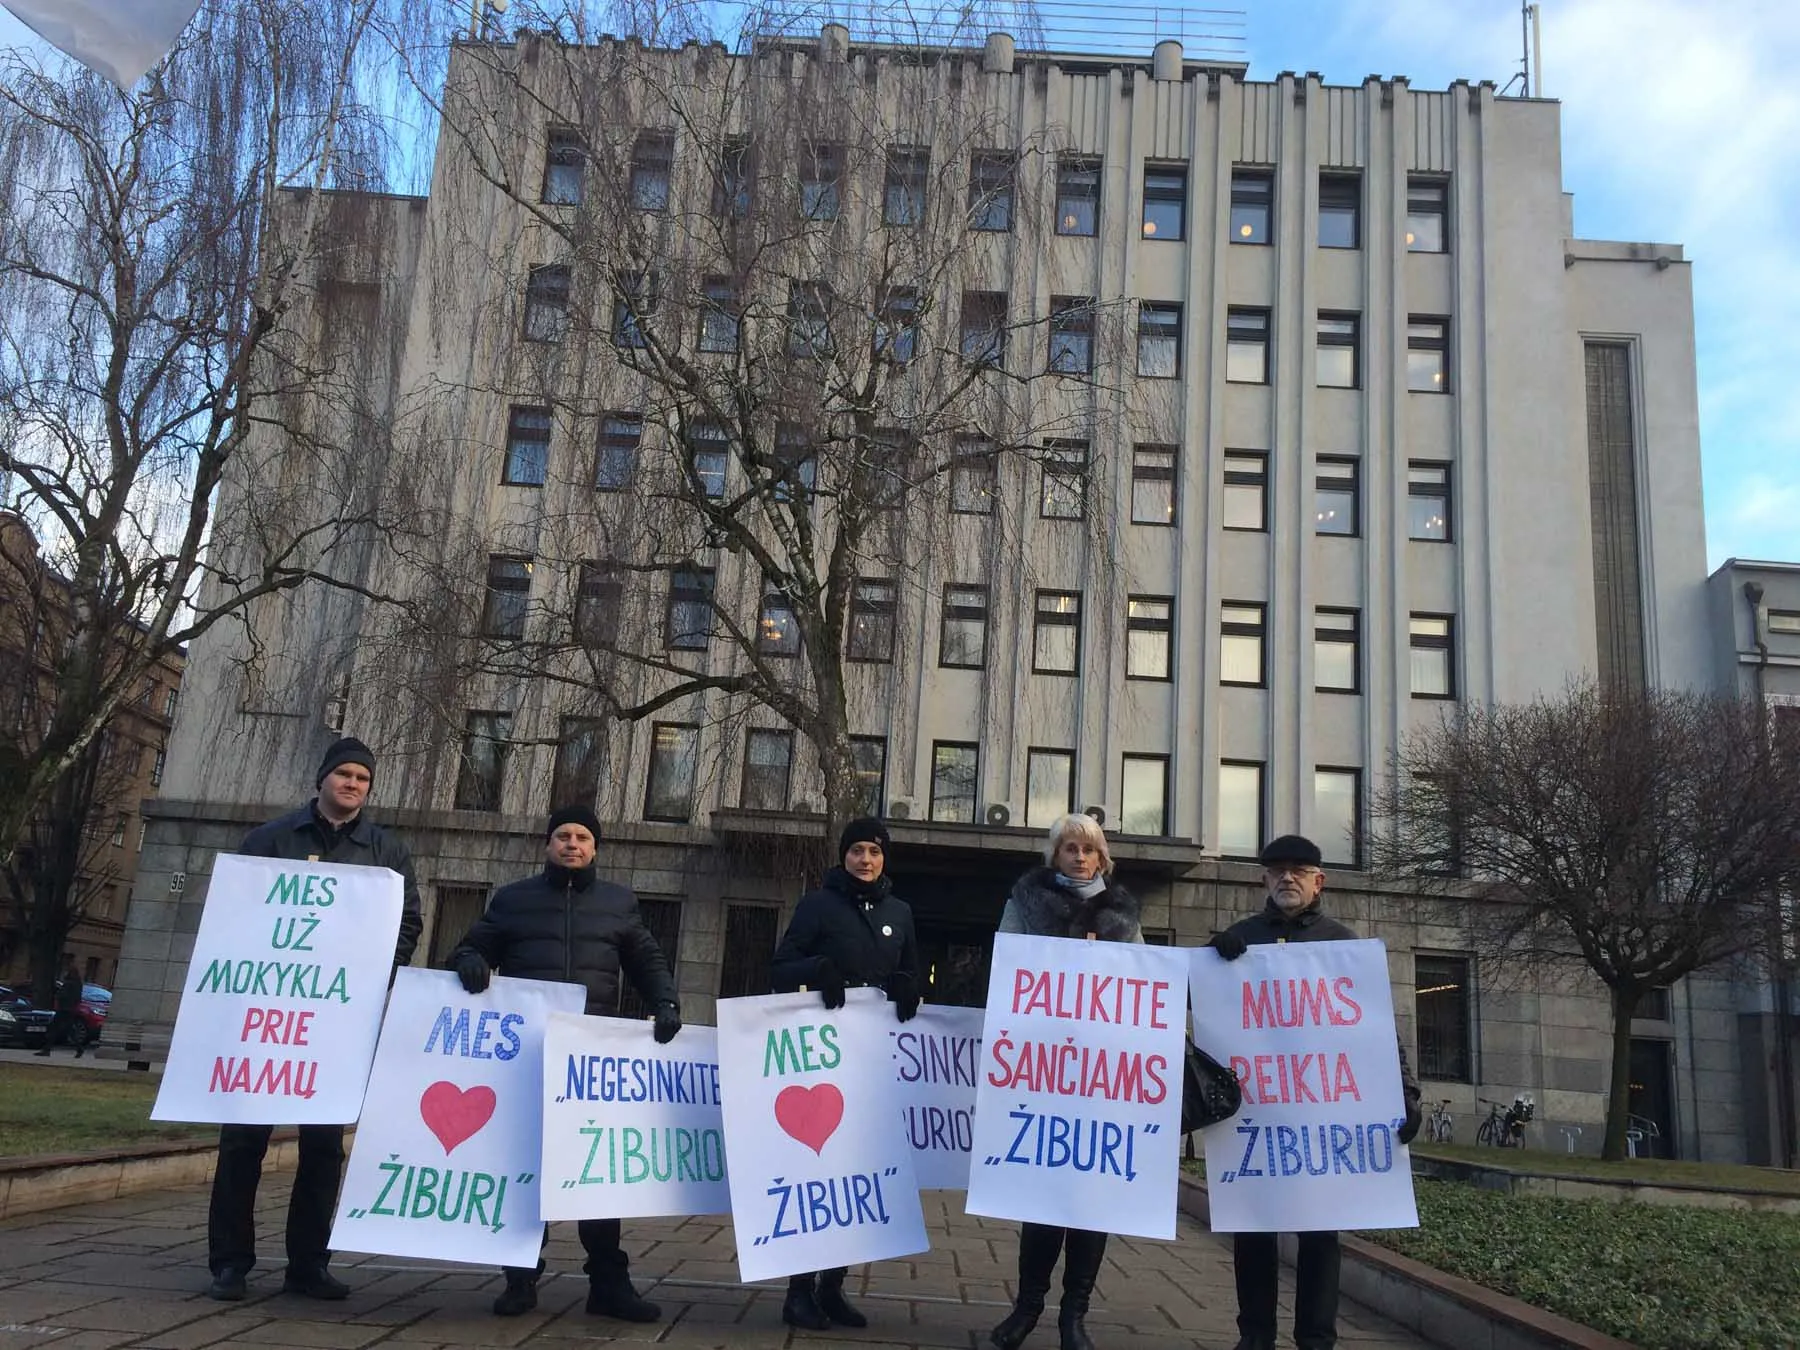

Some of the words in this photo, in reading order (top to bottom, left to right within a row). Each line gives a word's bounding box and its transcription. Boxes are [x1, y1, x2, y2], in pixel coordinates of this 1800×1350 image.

[171, 874, 185, 890] 96
[265, 873, 337, 907] MES
[272, 912, 320, 951] UŽ
[196, 959, 351, 1004] MOKYKLĄ
[1011, 968, 1169, 1029] PALIKITE
[1242, 976, 1362, 1030] MUMS
[241, 1008, 315, 1046] PRIE
[424, 1006, 525, 1061] MES
[762, 1023, 841, 1077] MES
[209, 1057, 318, 1099] NAMŲ
[889, 1031, 982, 1088] SINKI
[988, 1030, 1167, 1105] ŠANČIAMS
[1230, 1053, 1362, 1105] REIKIA
